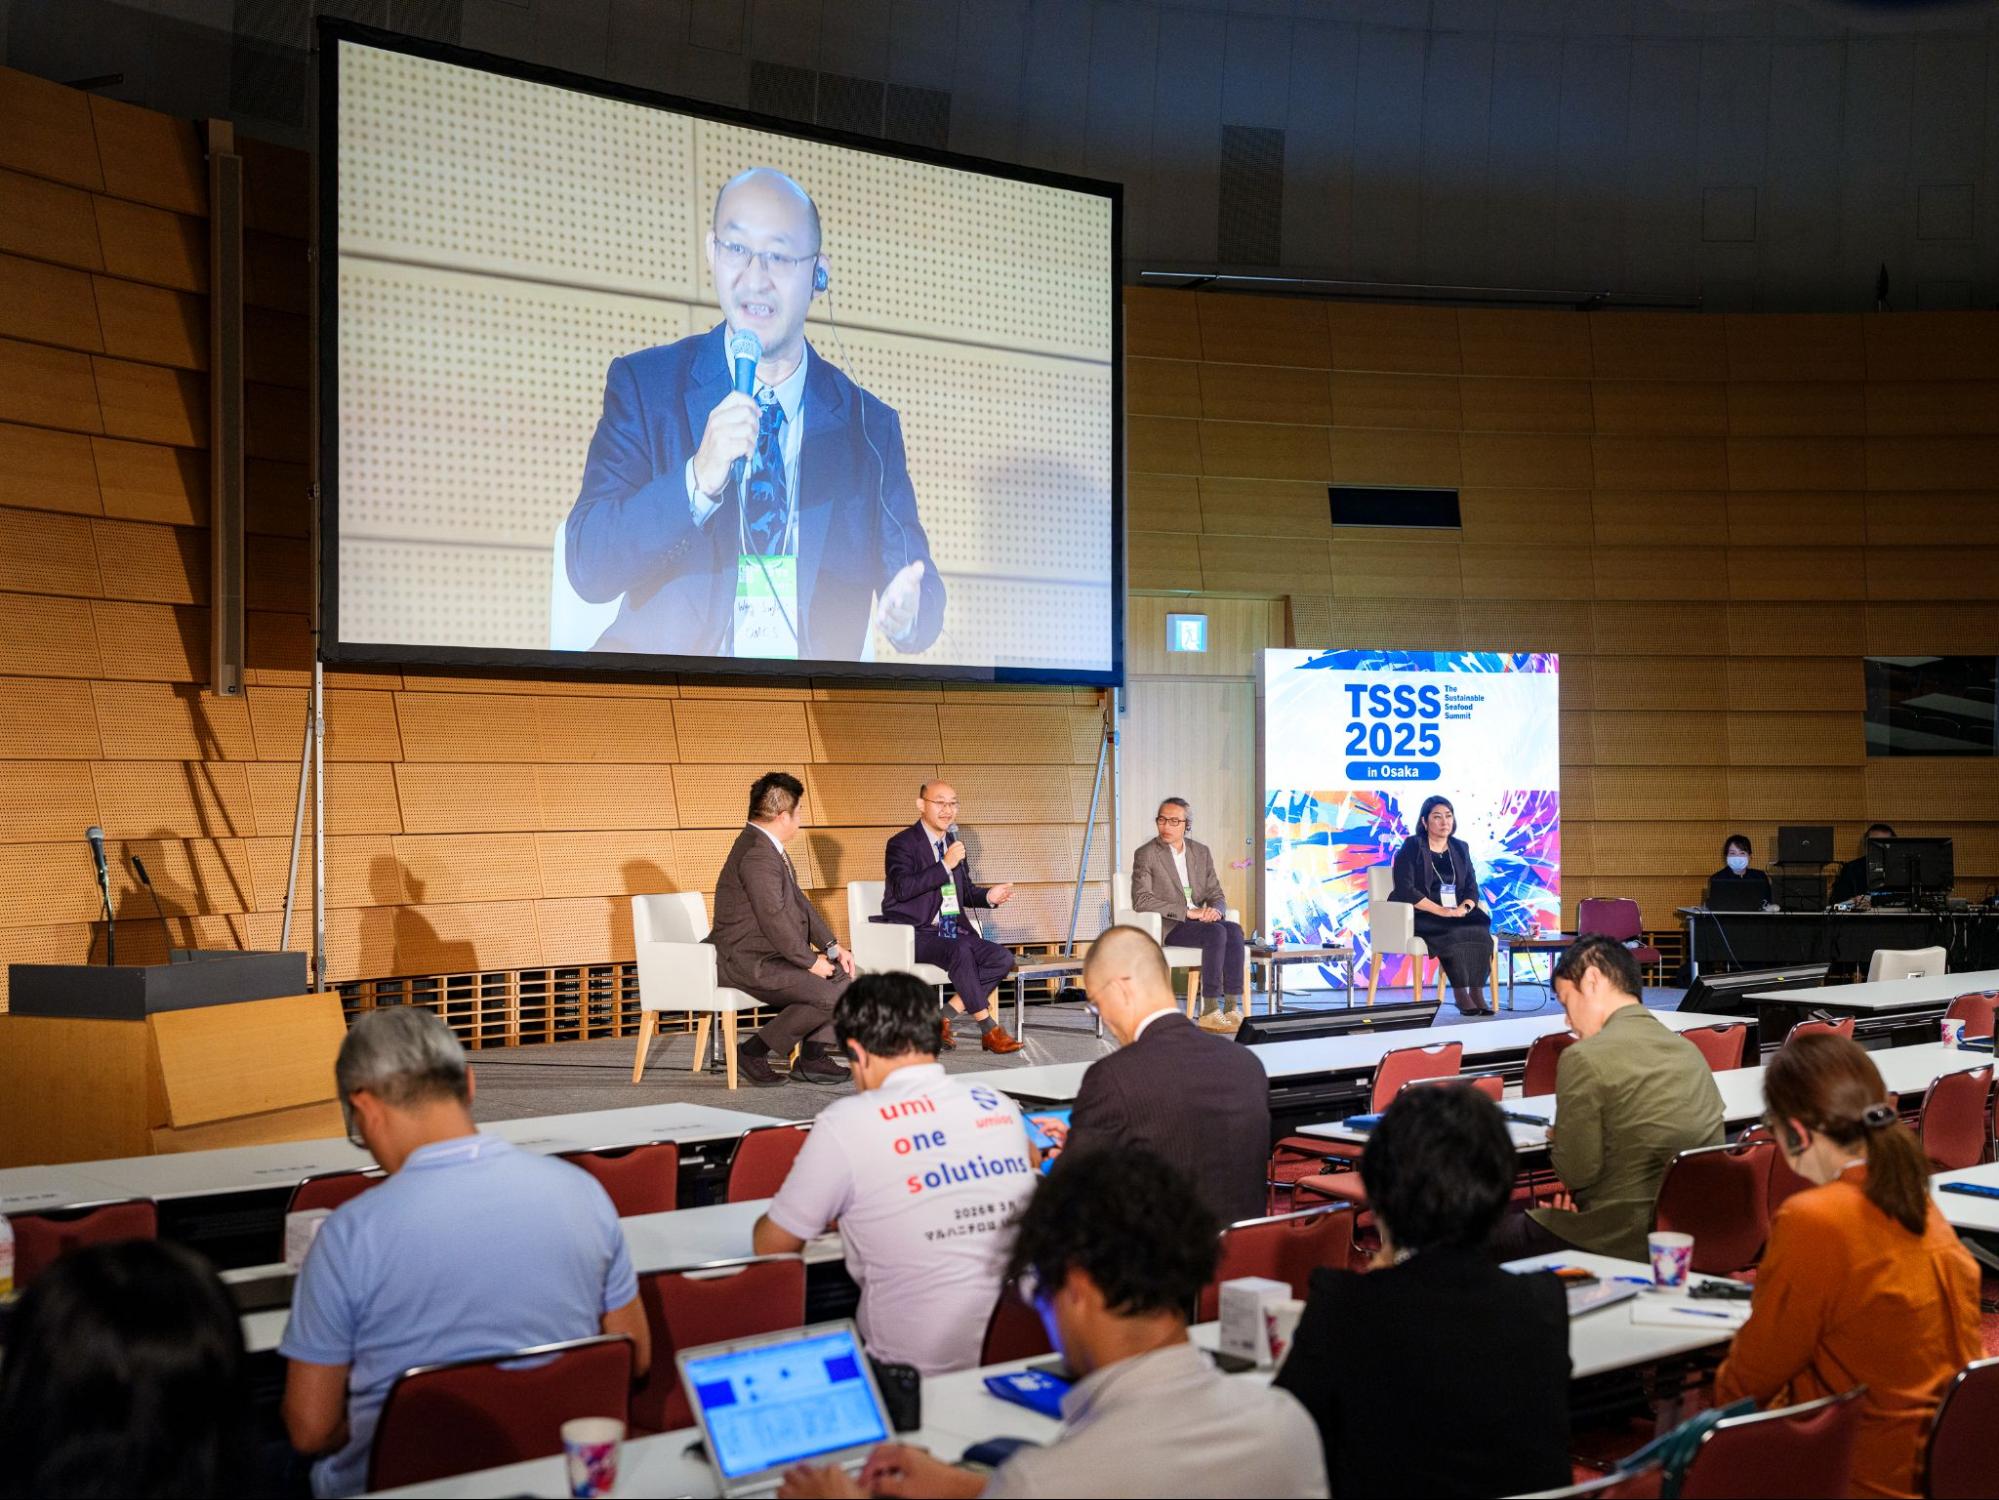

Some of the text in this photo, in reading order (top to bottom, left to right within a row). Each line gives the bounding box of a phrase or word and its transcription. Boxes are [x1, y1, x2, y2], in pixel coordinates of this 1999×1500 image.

[1344, 684, 1441, 719] TSSS
[1345, 722, 1441, 757] 2025
[1367, 765, 1419, 778] in Osaka
[880, 1095, 935, 1121] umi
[894, 1129, 946, 1154] one
[907, 1155, 1027, 1194] solutions
